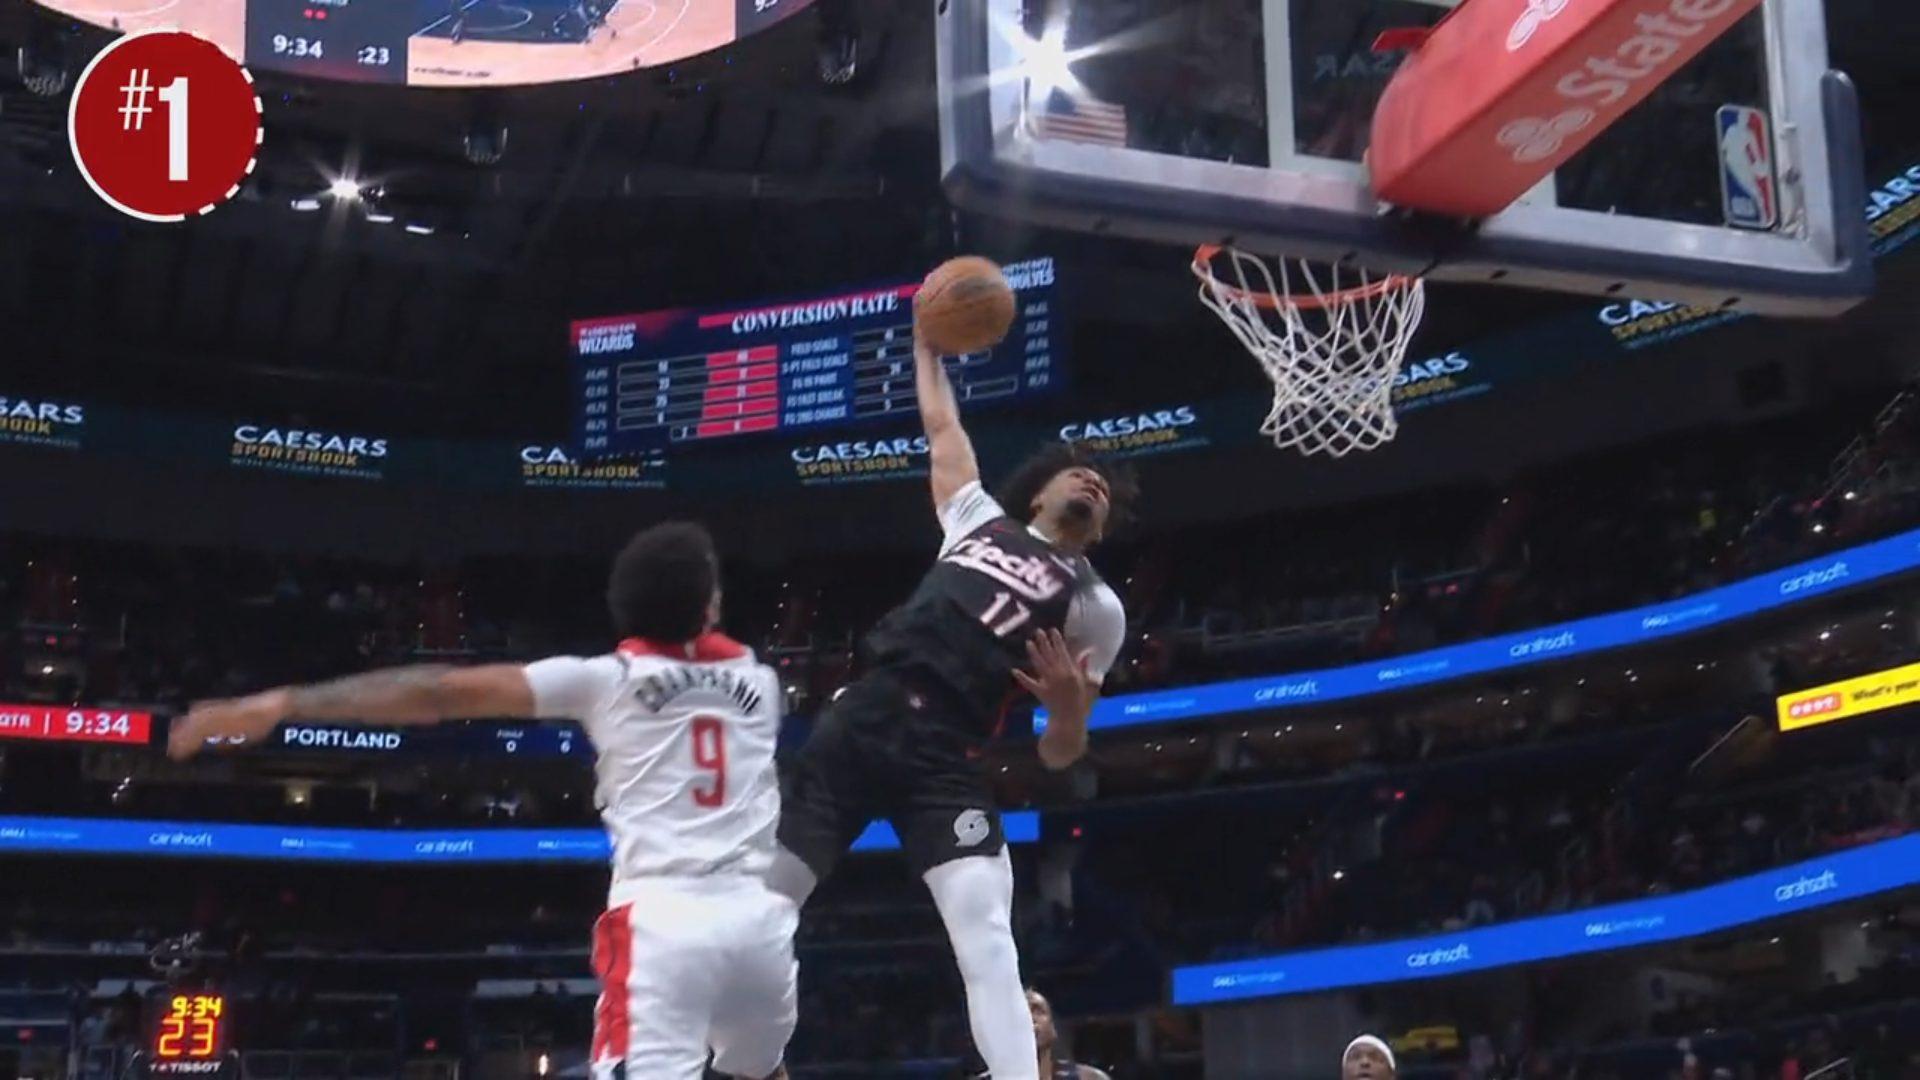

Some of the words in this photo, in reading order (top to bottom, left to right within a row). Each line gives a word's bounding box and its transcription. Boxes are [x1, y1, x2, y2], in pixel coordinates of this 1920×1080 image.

[273, 34, 324, 60] 9:34
[358, 46, 391, 65] :23
[731, 299, 848, 334] CONVERSION
[851, 290, 899, 317] RATE
[578, 333, 634, 354] WIZARDS
[1059, 405, 1196, 443] CAESARS
[231, 441, 360, 467] SPORTSBOOK
[234, 425, 388, 457] CAESARS
[791, 435, 930, 463] CAESARS
[1779, 562, 1850, 595] carahsoft
[979, 592, 1031, 637] 17
[1509, 631, 1576, 657] carahsoft
[1254, 678, 1320, 701] carahsoft
[66, 711, 131, 737] 9:34
[284, 727, 401, 750] PORTLAND
[506, 740, 517, 753] 0
[690, 714, 726, 808] 9
[149, 832, 212, 847] carahsoft
[415, 838, 475, 854] carahsoft
[1774, 869, 1839, 902] carahsoft
[1406, 943, 1472, 968] carahsoft
[172, 996, 222, 1018] 9:34
[158, 1017, 215, 1056] 23
